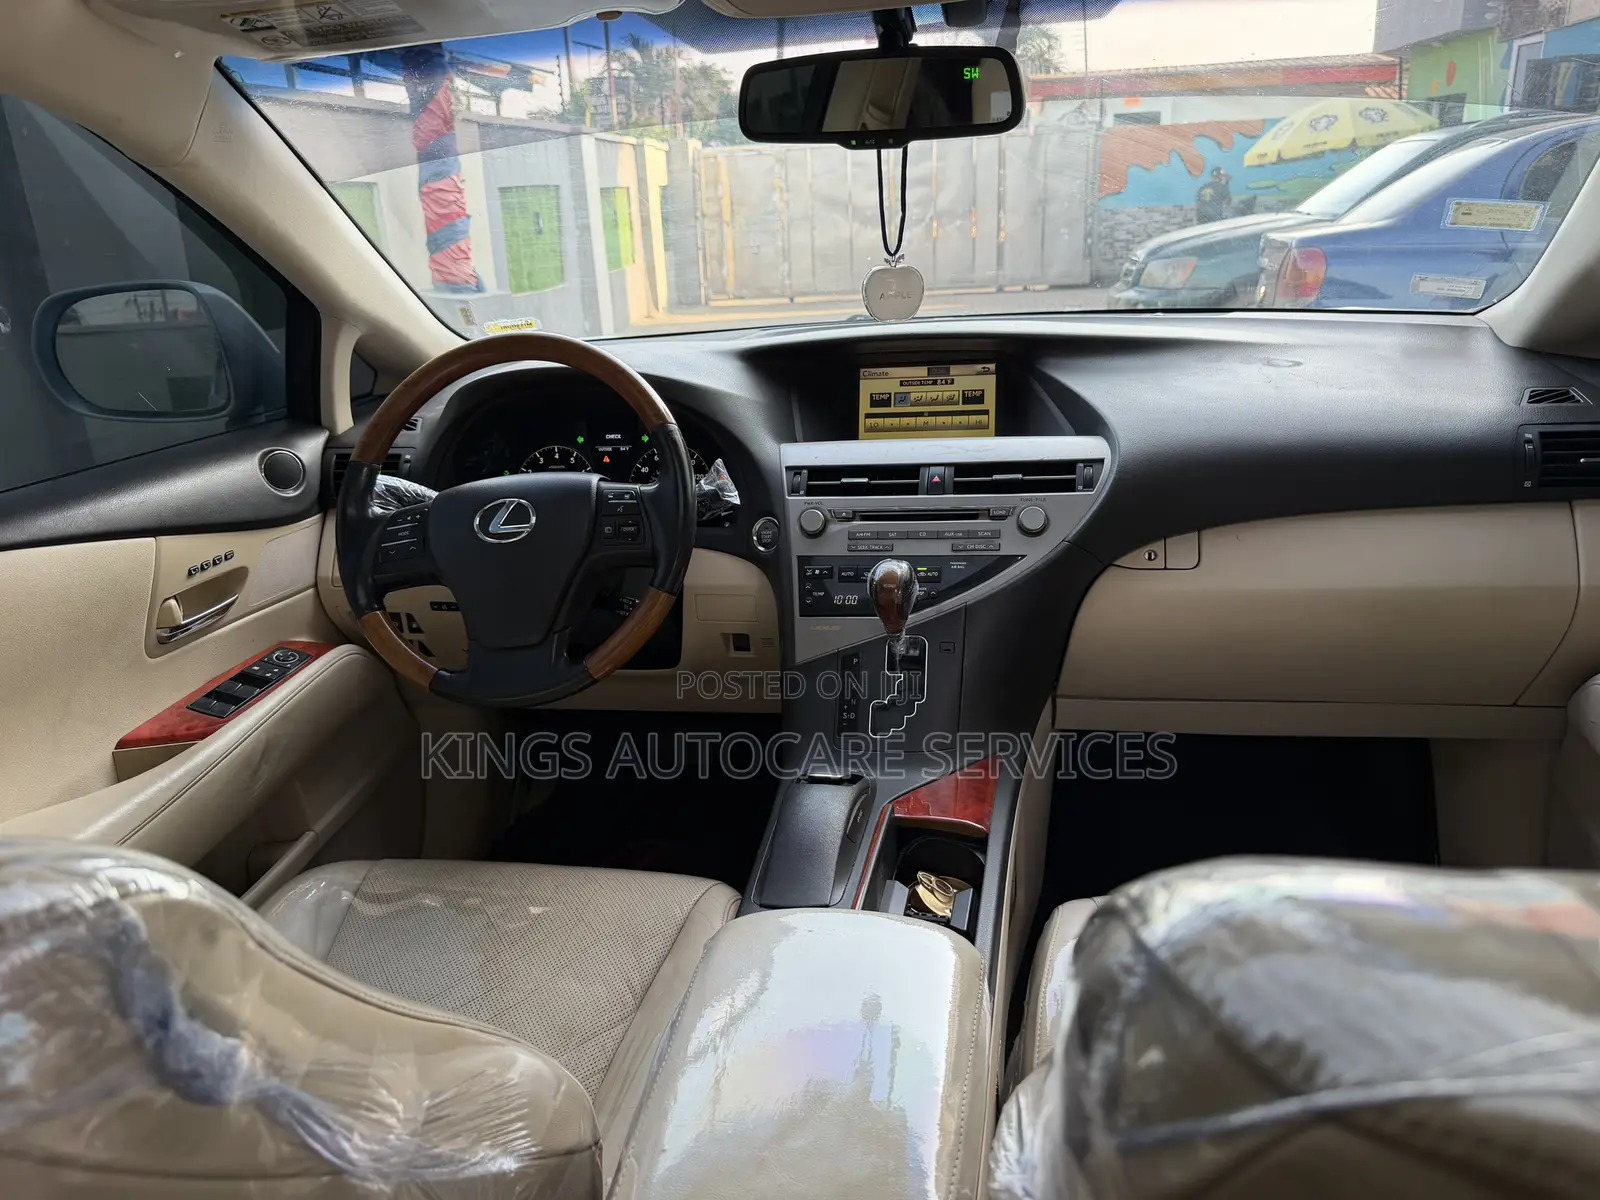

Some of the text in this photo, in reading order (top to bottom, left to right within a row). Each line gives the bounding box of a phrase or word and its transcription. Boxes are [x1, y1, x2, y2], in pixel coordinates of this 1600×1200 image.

[963, 67, 979, 79] SW
[879, 291, 913, 301] APPLE
[872, 393, 890, 401] TEMP
[963, 390, 983, 398] TEMP
